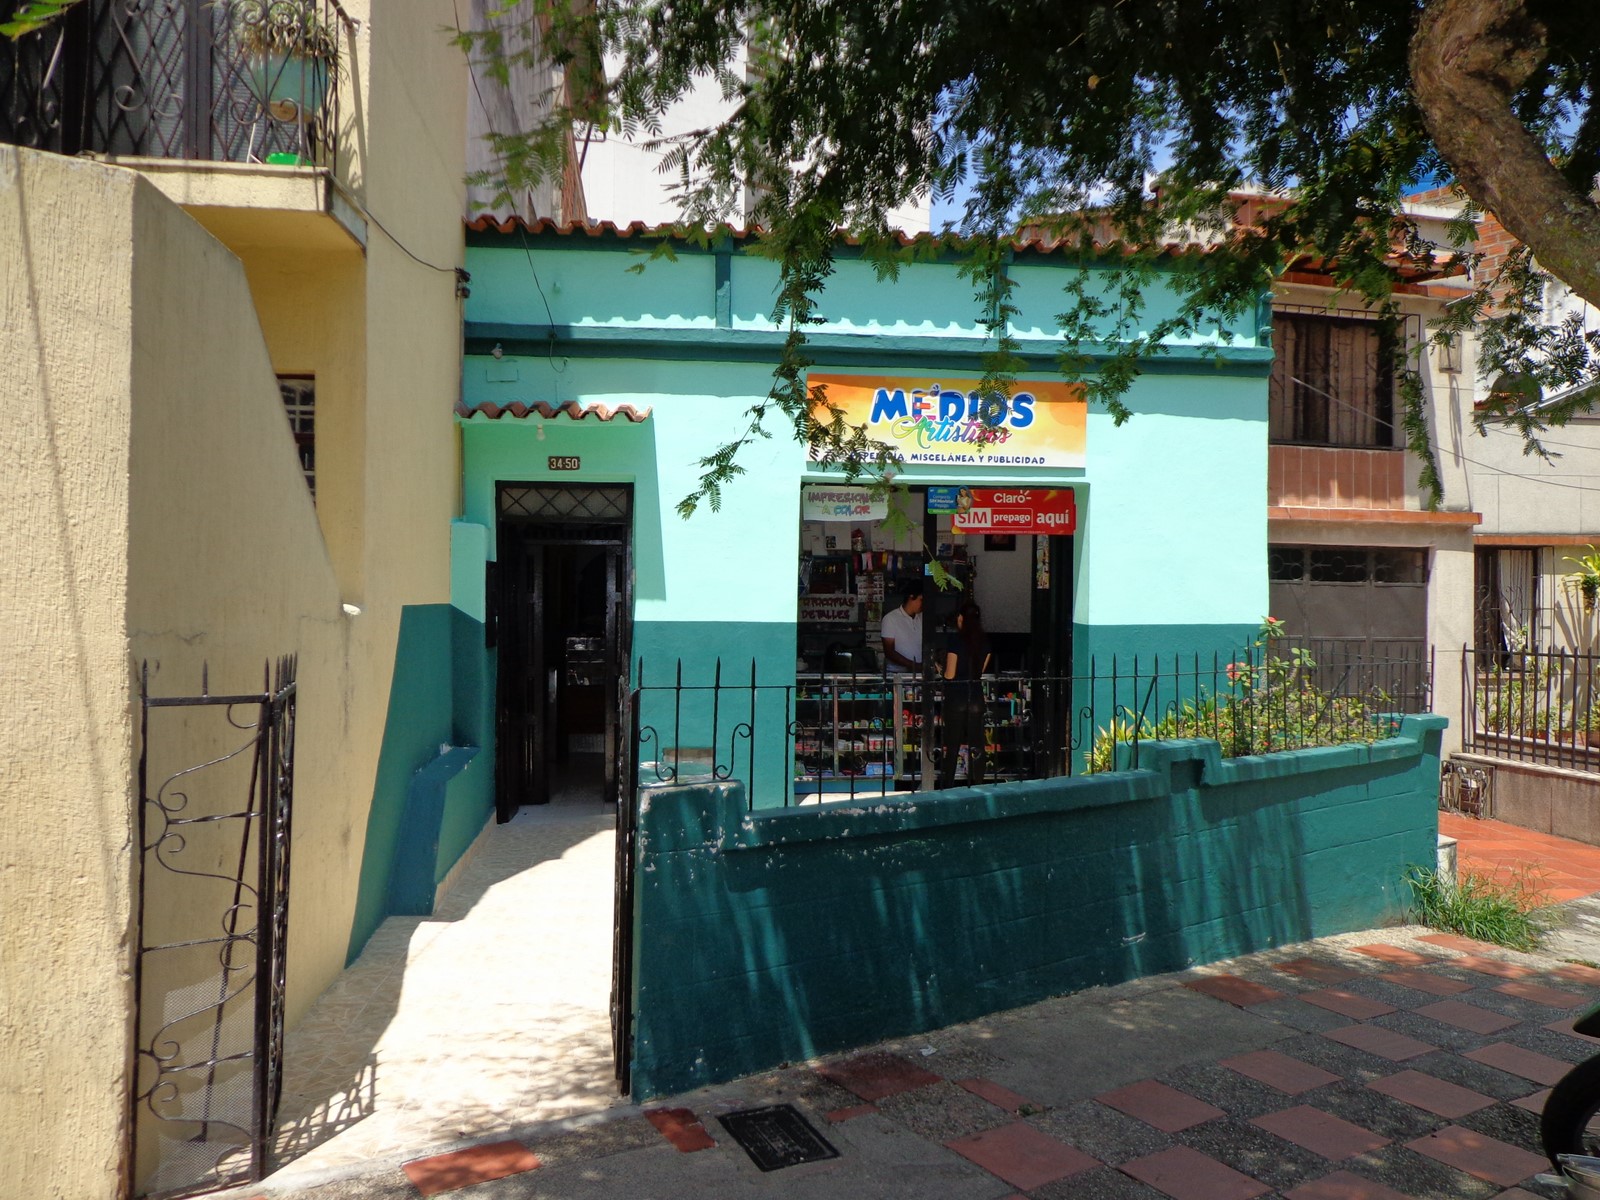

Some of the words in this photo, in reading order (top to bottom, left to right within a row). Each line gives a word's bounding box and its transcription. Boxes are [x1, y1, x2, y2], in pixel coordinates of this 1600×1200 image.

[871, 389, 1034, 428] MEDIOS
[910, 453, 975, 463] MISCELÁNEA
[988, 456, 1045, 464] PUBLICIDAD
[993, 492, 1028, 504] Claro
[821, 505, 831, 515] A
[834, 504, 871, 516] COLOR
[958, 511, 988, 524] SIM
[993, 513, 1031, 523] prepago
[1036, 510, 1069, 527] aquí
